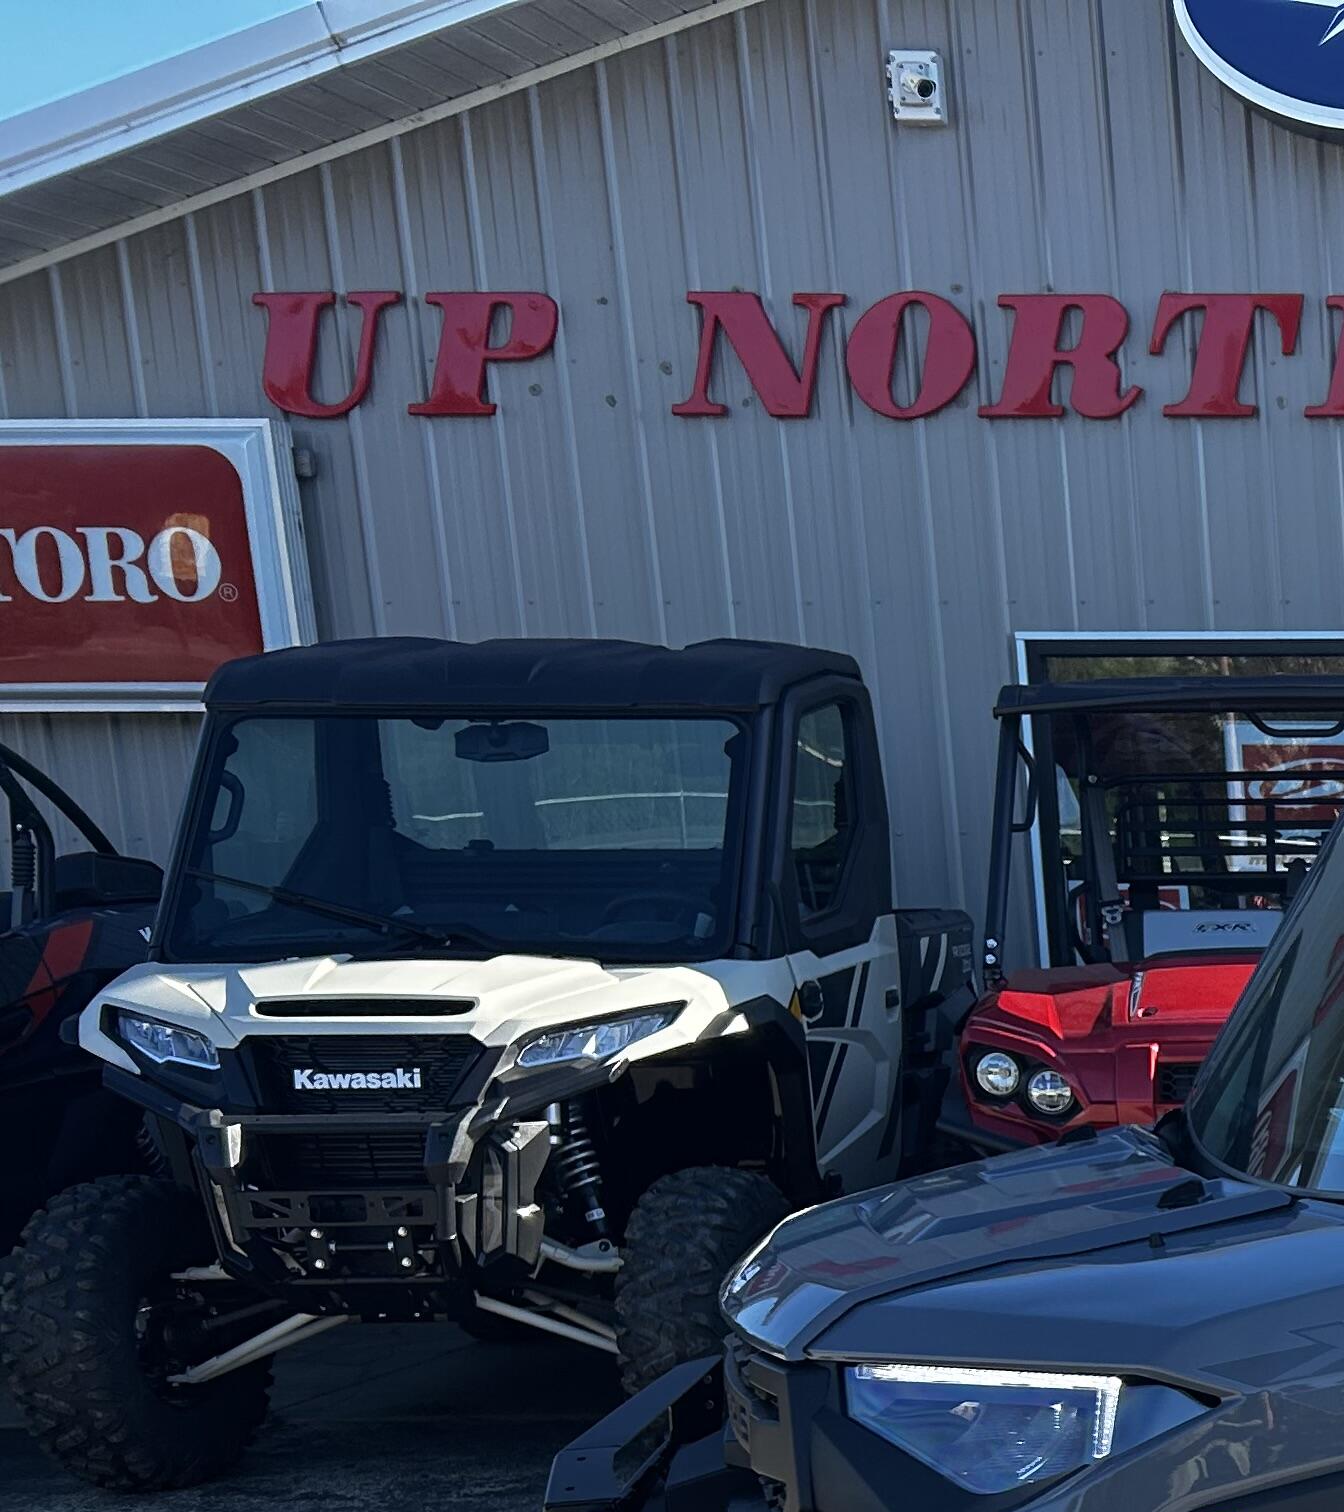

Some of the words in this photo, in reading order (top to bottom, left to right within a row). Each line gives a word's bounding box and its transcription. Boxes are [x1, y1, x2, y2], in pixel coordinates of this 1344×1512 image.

[252, 290, 559, 418] UP
[0, 525, 222, 603] ORO
[293, 1067, 422, 1090] Kawasaki
